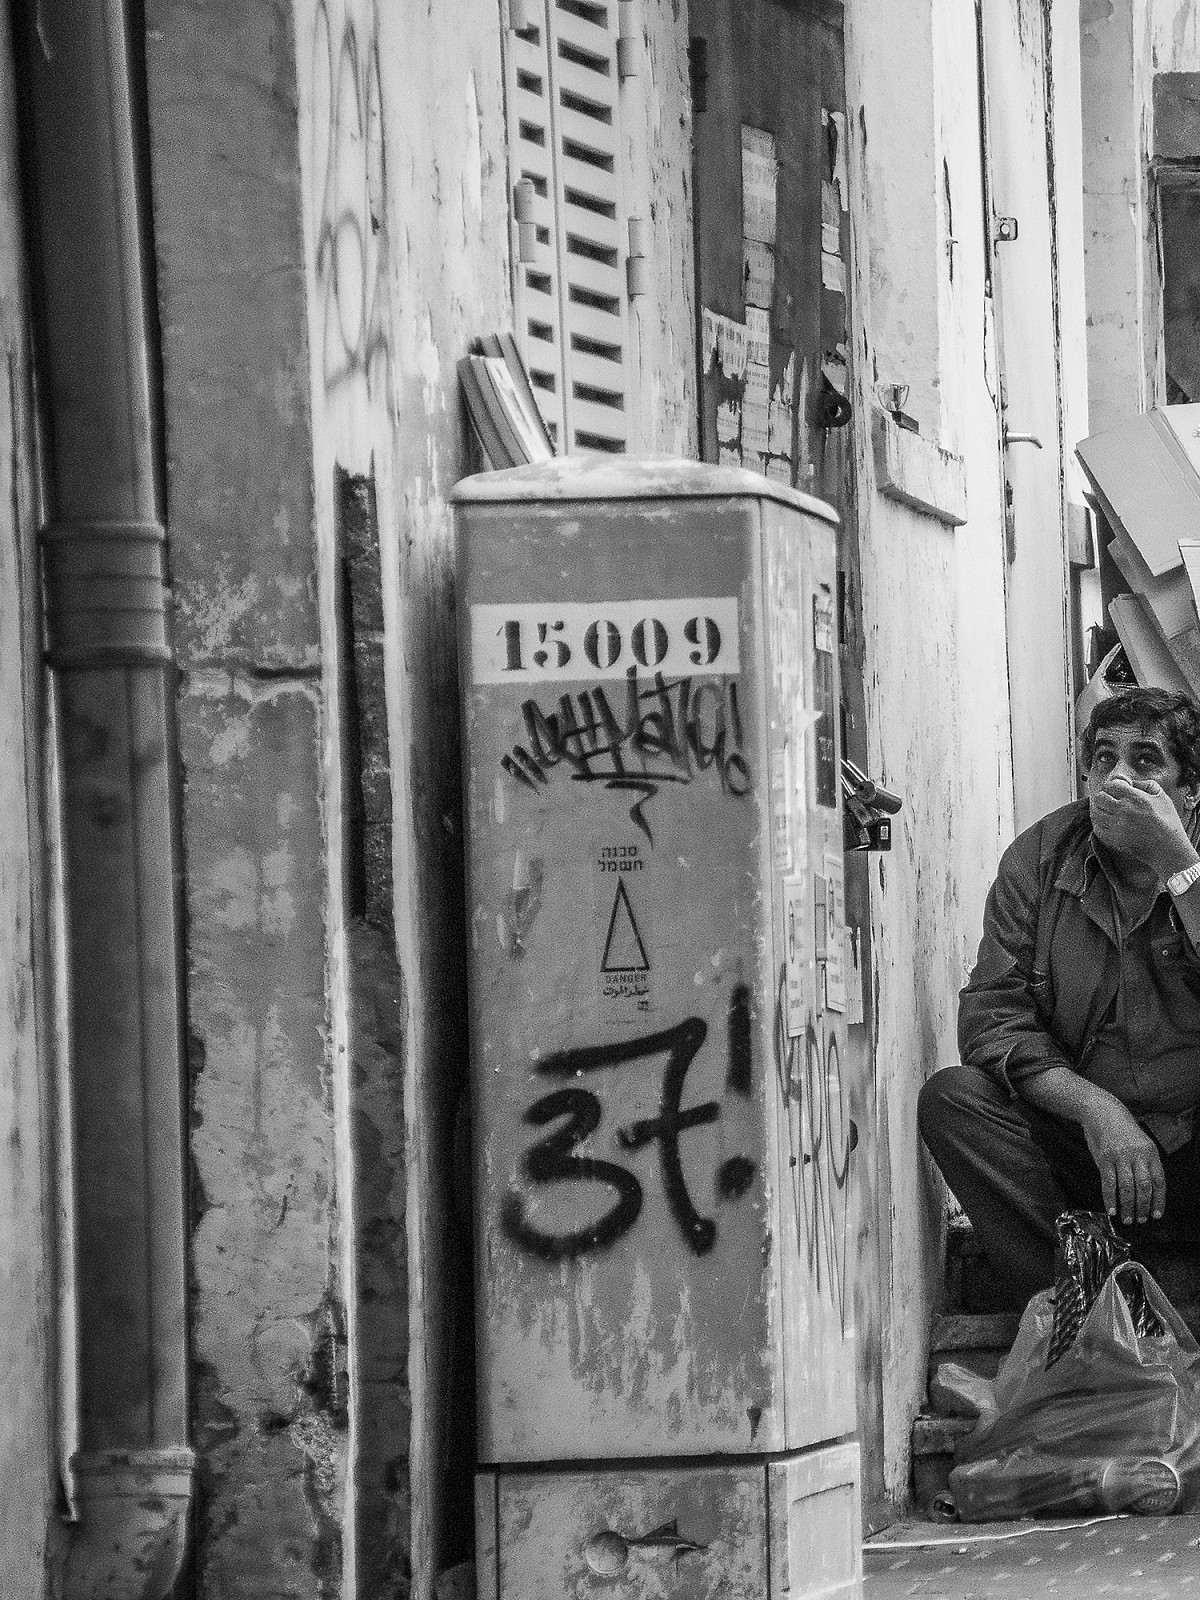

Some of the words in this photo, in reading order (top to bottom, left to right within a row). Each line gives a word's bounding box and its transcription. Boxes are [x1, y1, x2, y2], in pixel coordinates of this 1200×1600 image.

[496, 616, 722, 671] 15009
[598, 859, 643, 872] חשמל
[604, 973, 647, 985] DANGER
